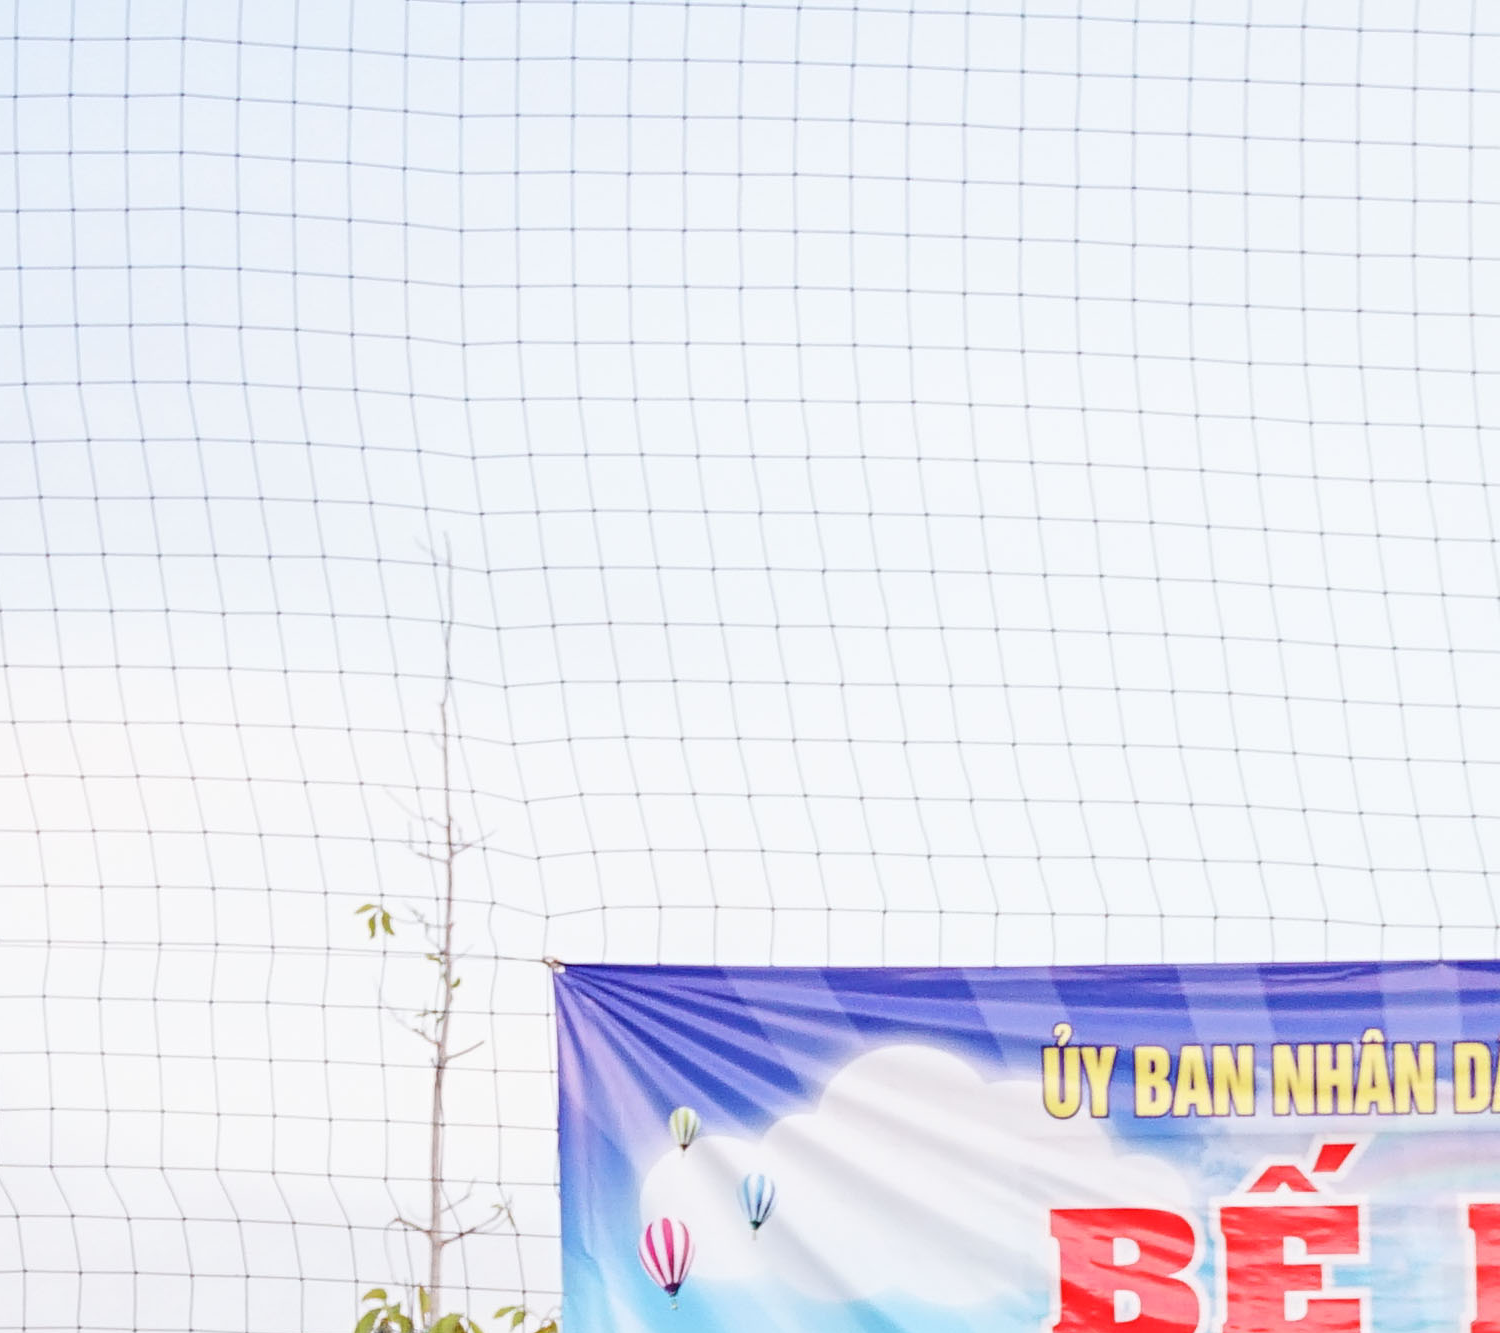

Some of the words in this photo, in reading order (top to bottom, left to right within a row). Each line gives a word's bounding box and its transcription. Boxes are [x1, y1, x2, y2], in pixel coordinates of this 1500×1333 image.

[1041, 1023, 1117, 1119] ỦY
[1134, 1044, 1255, 1118] BAN
[1272, 1028, 1436, 1116] NHÂN
